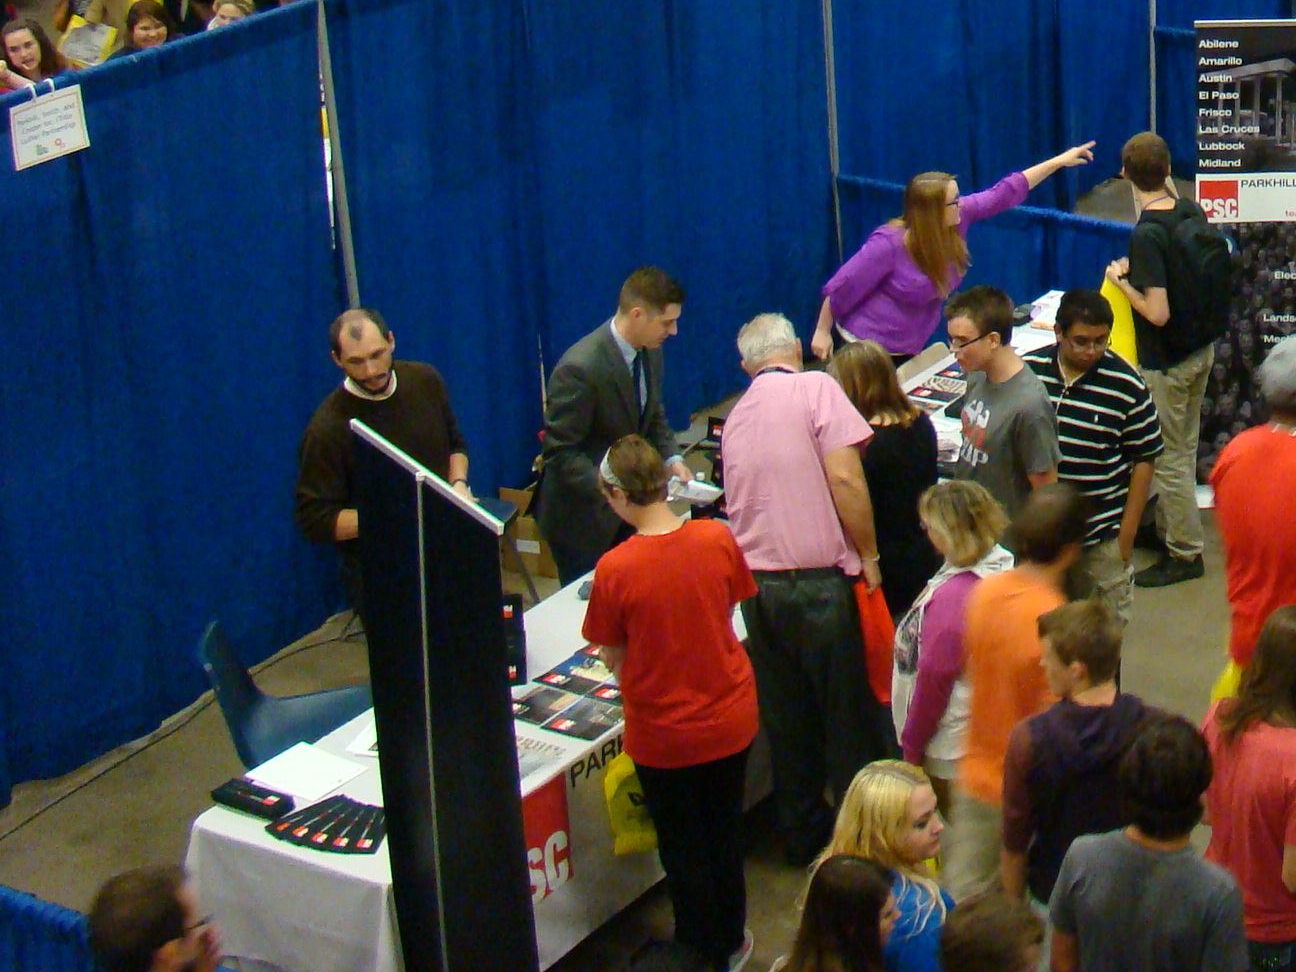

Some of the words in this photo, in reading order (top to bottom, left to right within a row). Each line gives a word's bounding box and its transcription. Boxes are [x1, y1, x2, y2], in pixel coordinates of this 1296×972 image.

[1199, 39, 1239, 48] Abilene
[1199, 56, 1242, 65] Amarillo
[1199, 74, 1233, 83] Austin
[1199, 91, 1210, 100] El
[1211, 91, 1239, 100] Paso
[1199, 108, 1232, 117] Frisco
[1199, 125, 1219, 134] Las
[1221, 124, 1260, 134] Cruces
[1199, 141, 1245, 150] Lubbock
[1199, 158, 1241, 167] Midland
[1201, 198, 1239, 219] PSC
[528, 830, 571, 901] SC
